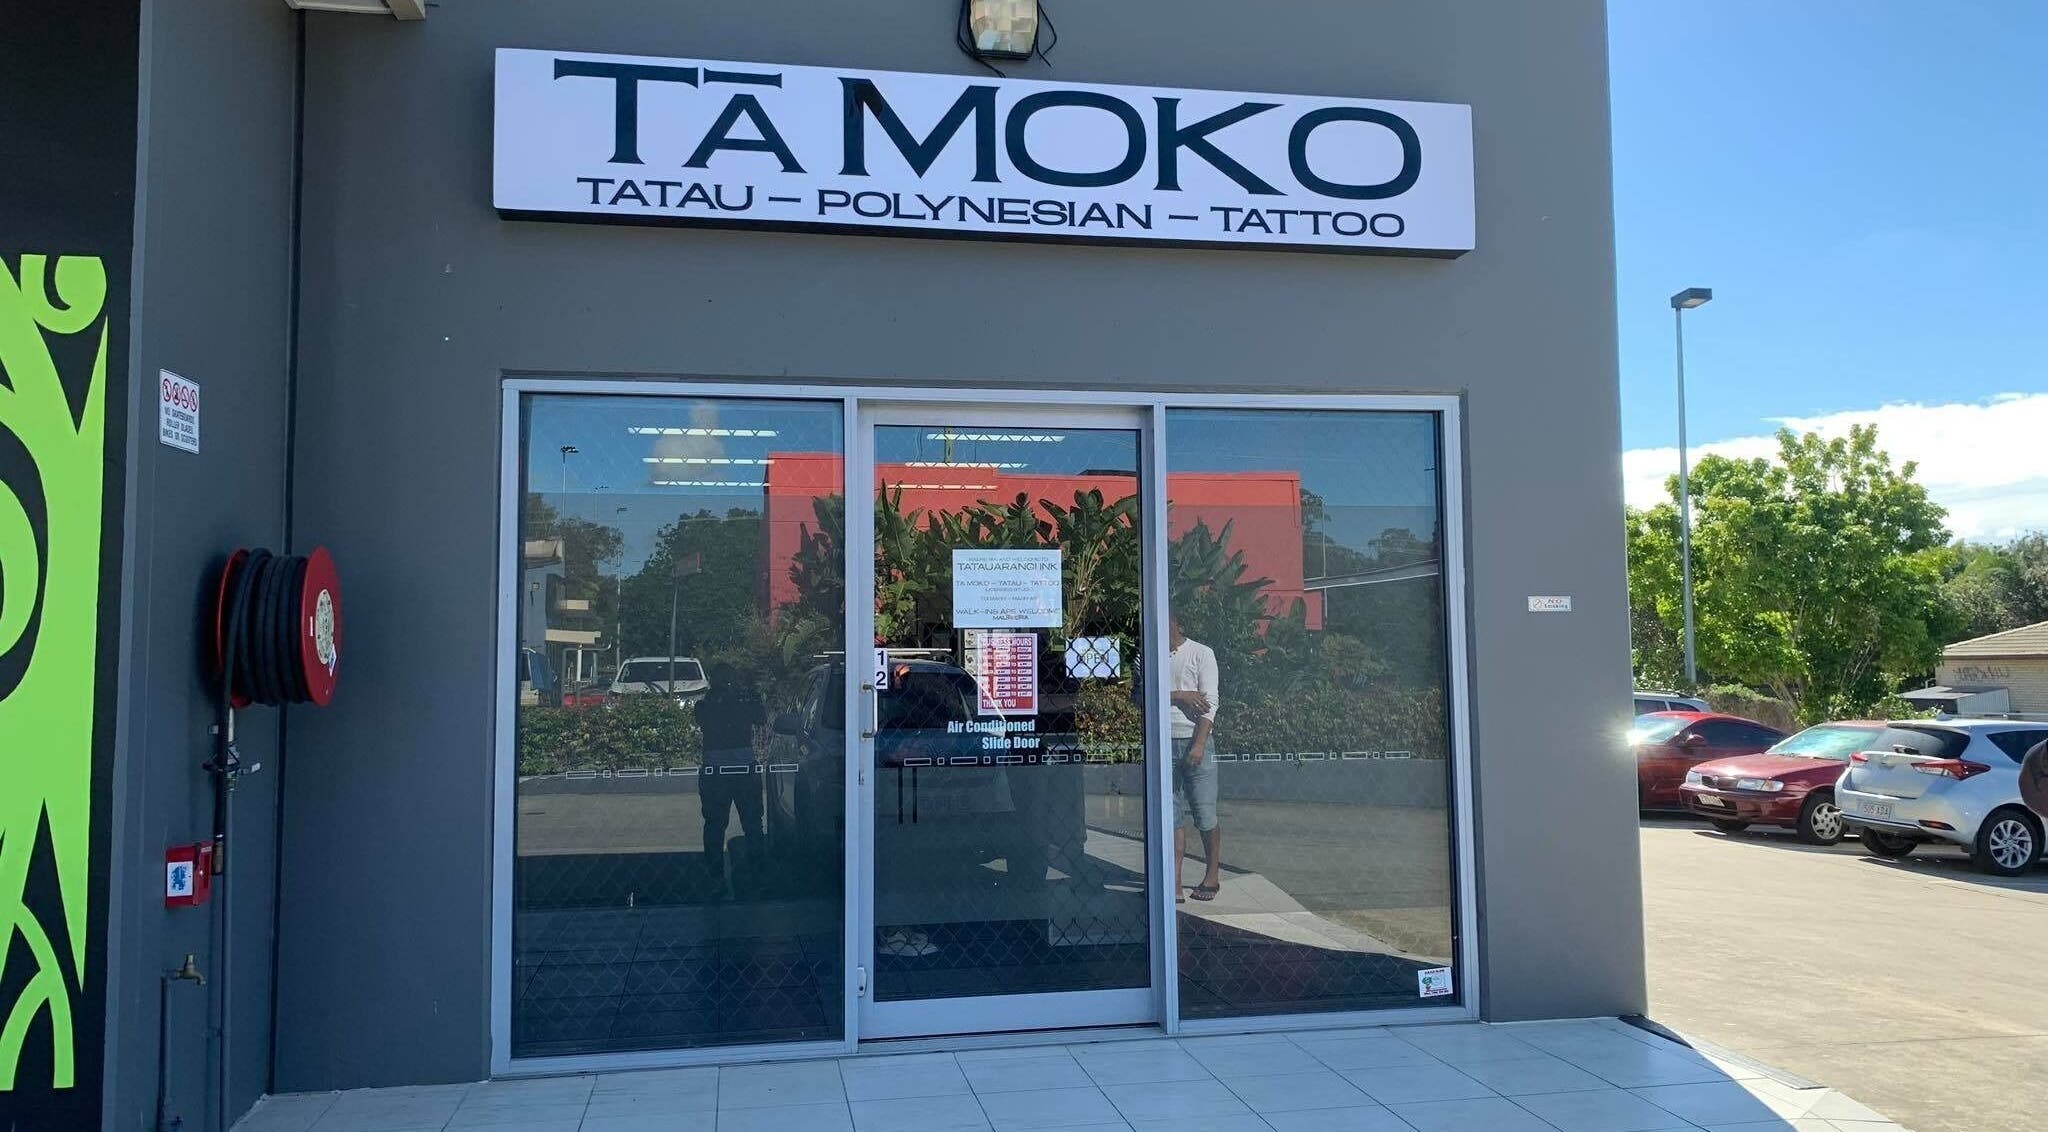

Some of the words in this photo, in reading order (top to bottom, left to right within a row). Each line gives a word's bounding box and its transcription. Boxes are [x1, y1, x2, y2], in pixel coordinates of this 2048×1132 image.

[837, 76, 1422, 201] MOKO
[576, 176, 755, 211] TATAU
[818, 189, 1153, 230] POLYNESIAN
[1210, 206, 1405, 238] TATTOO
[982, 637, 1010, 646] BUSESS
[1003, 698, 1017, 708] YOU
[947, 720, 964, 733] Air
[965, 719, 1035, 733] Conditioned
[982, 736, 1011, 750] Slide
[1013, 736, 1040, 750] Door
